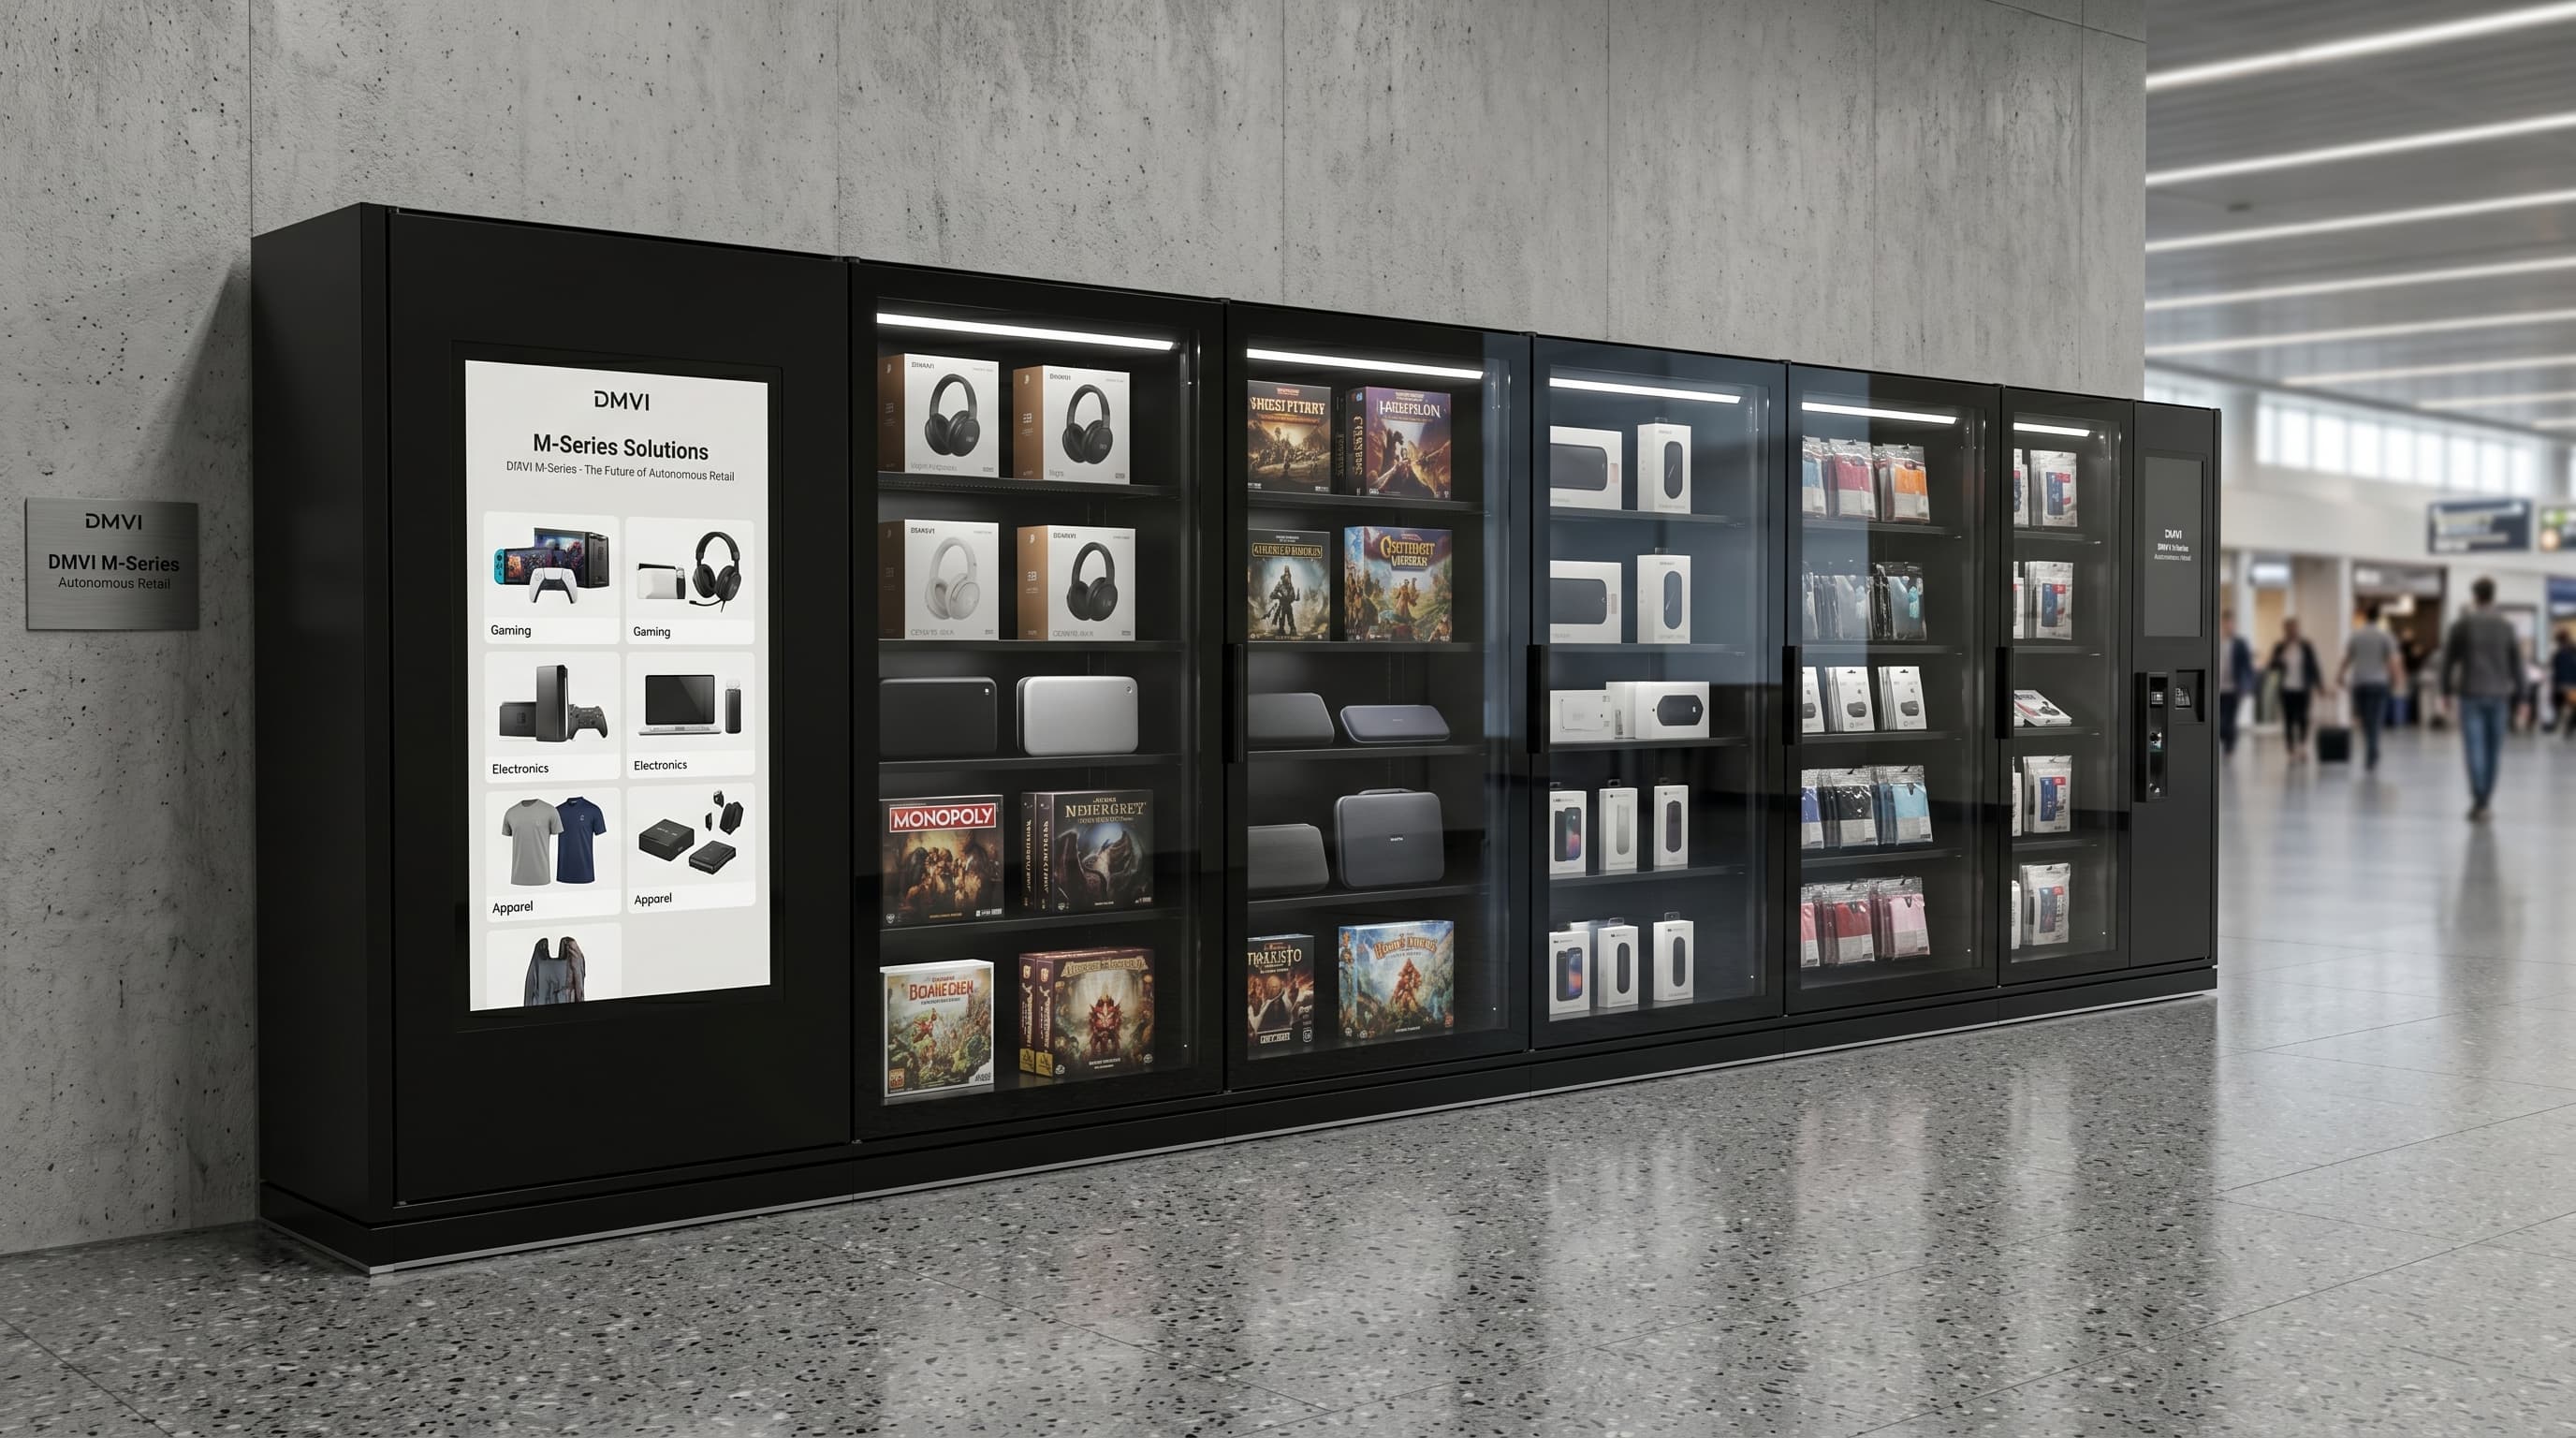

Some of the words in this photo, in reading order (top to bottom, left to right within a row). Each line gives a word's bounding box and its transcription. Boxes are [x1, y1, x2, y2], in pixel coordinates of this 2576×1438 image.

[593, 389, 650, 412] DMVI
[533, 433, 618, 456] M-Series
[623, 438, 710, 462] Solutions
[534, 462, 578, 475] M-Series
[584, 464, 603, 477] The
[605, 465, 635, 477] Future
[637, 466, 647, 477] of
[649, 467, 708, 481] Autonomous
[710, 470, 735, 481] Retail
[85, 513, 142, 530] DMVI
[49, 553, 95, 570] DMVI
[102, 554, 180, 572] M-Series
[58, 576, 135, 589] Autonomous
[138, 578, 170, 590] Retail
[490, 624, 532, 638] Gaming
[633, 625, 671, 639] Gaming
[491, 763, 549, 775] Electronics
[634, 759, 688, 770] Electronics
[893, 807, 993, 829] MONOPOLY
[635, 892, 672, 906] Apparel
[492, 900, 534, 916] Apparel
